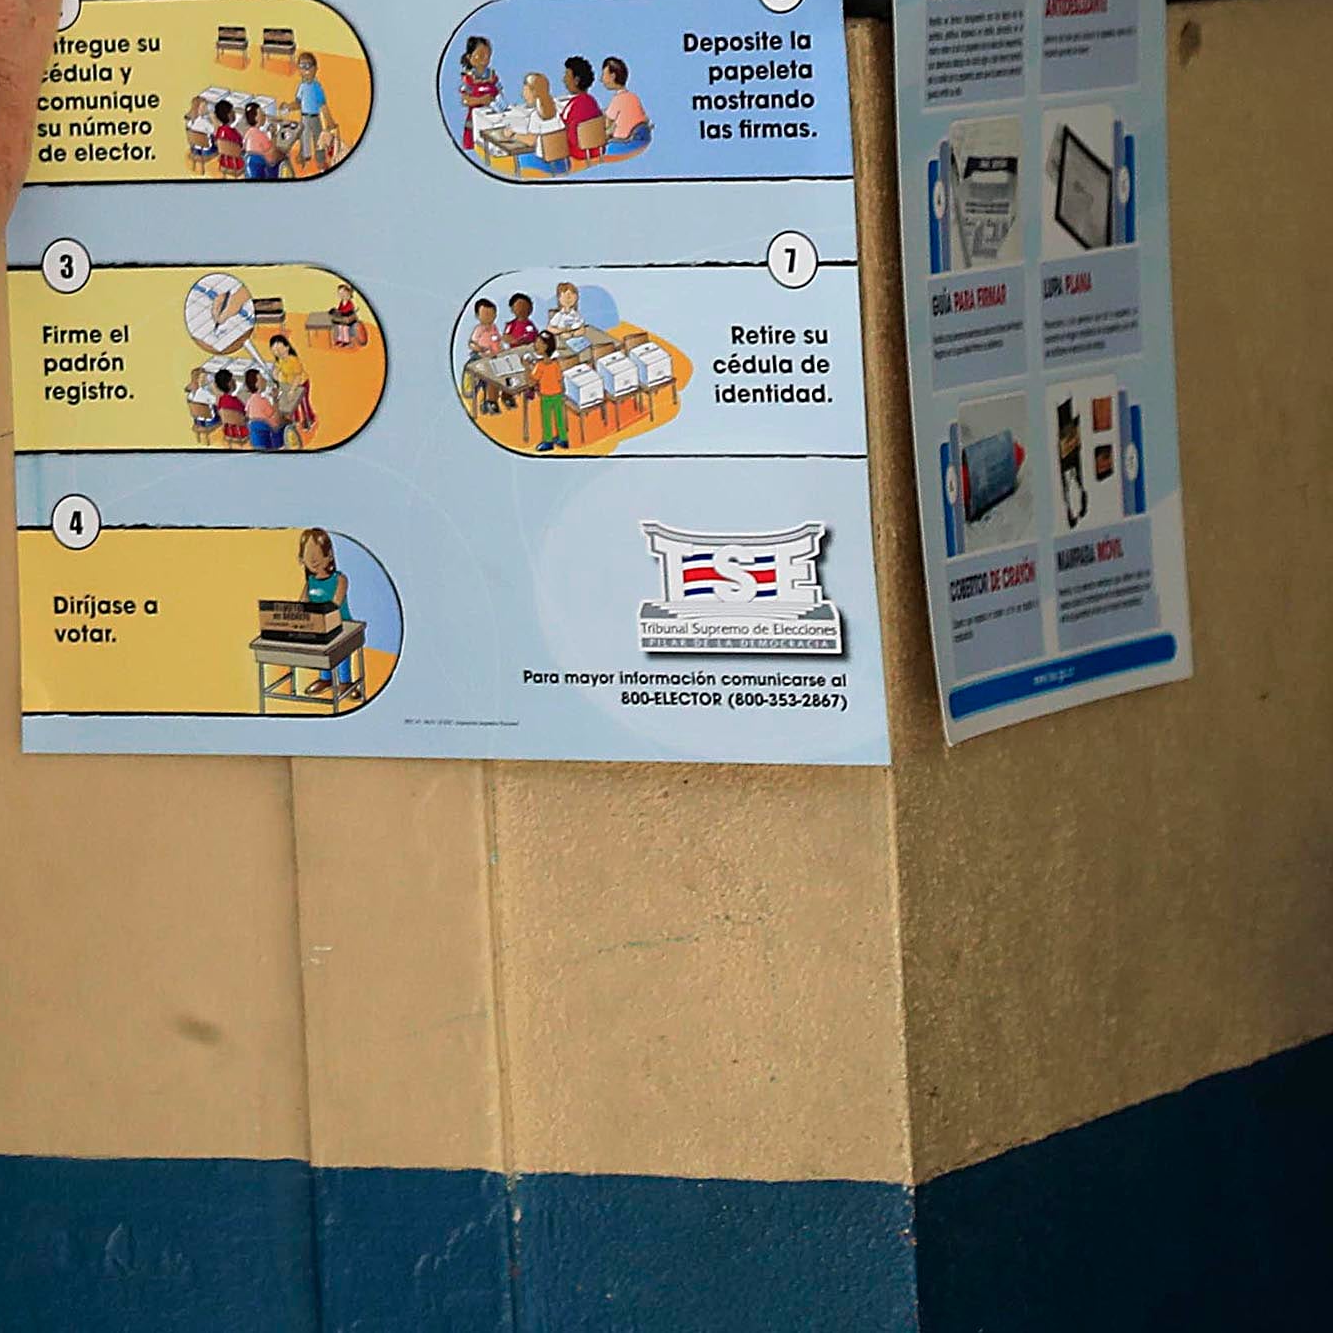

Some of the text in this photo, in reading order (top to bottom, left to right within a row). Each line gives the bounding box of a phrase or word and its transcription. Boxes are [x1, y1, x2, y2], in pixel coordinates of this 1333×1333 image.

[137, 37, 161, 53] su
[683, 30, 812, 54] Deposite la
[120, 67, 132, 85] y
[708, 59, 814, 85] papeleta
[37, 91, 161, 113] comunique
[691, 90, 816, 111] mostrando
[37, 117, 153, 137] su número
[699, 118, 819, 140] las firmas.
[38, 142, 157, 163] de elector.
[59, 253, 74, 279] 3
[783, 247, 796, 274] 7
[42, 324, 130, 345] Firme el
[731, 325, 829, 345] Retire su
[43, 352, 125, 377] padrón
[712, 353, 831, 375] cédula de
[44, 381, 135, 406] registro.
[713, 383, 834, 404] identidad.
[69, 511, 84, 536] 4
[52, 594, 160, 619] Diríjase a
[53, 624, 117, 644] votar.
[640, 621, 838, 637] Tribunal Supremo de Elecciones
[523, 669, 847, 689] Para mayor información comunicarse al
[620, 690, 848, 712] 800-ELECTOR (800-353-2867)
